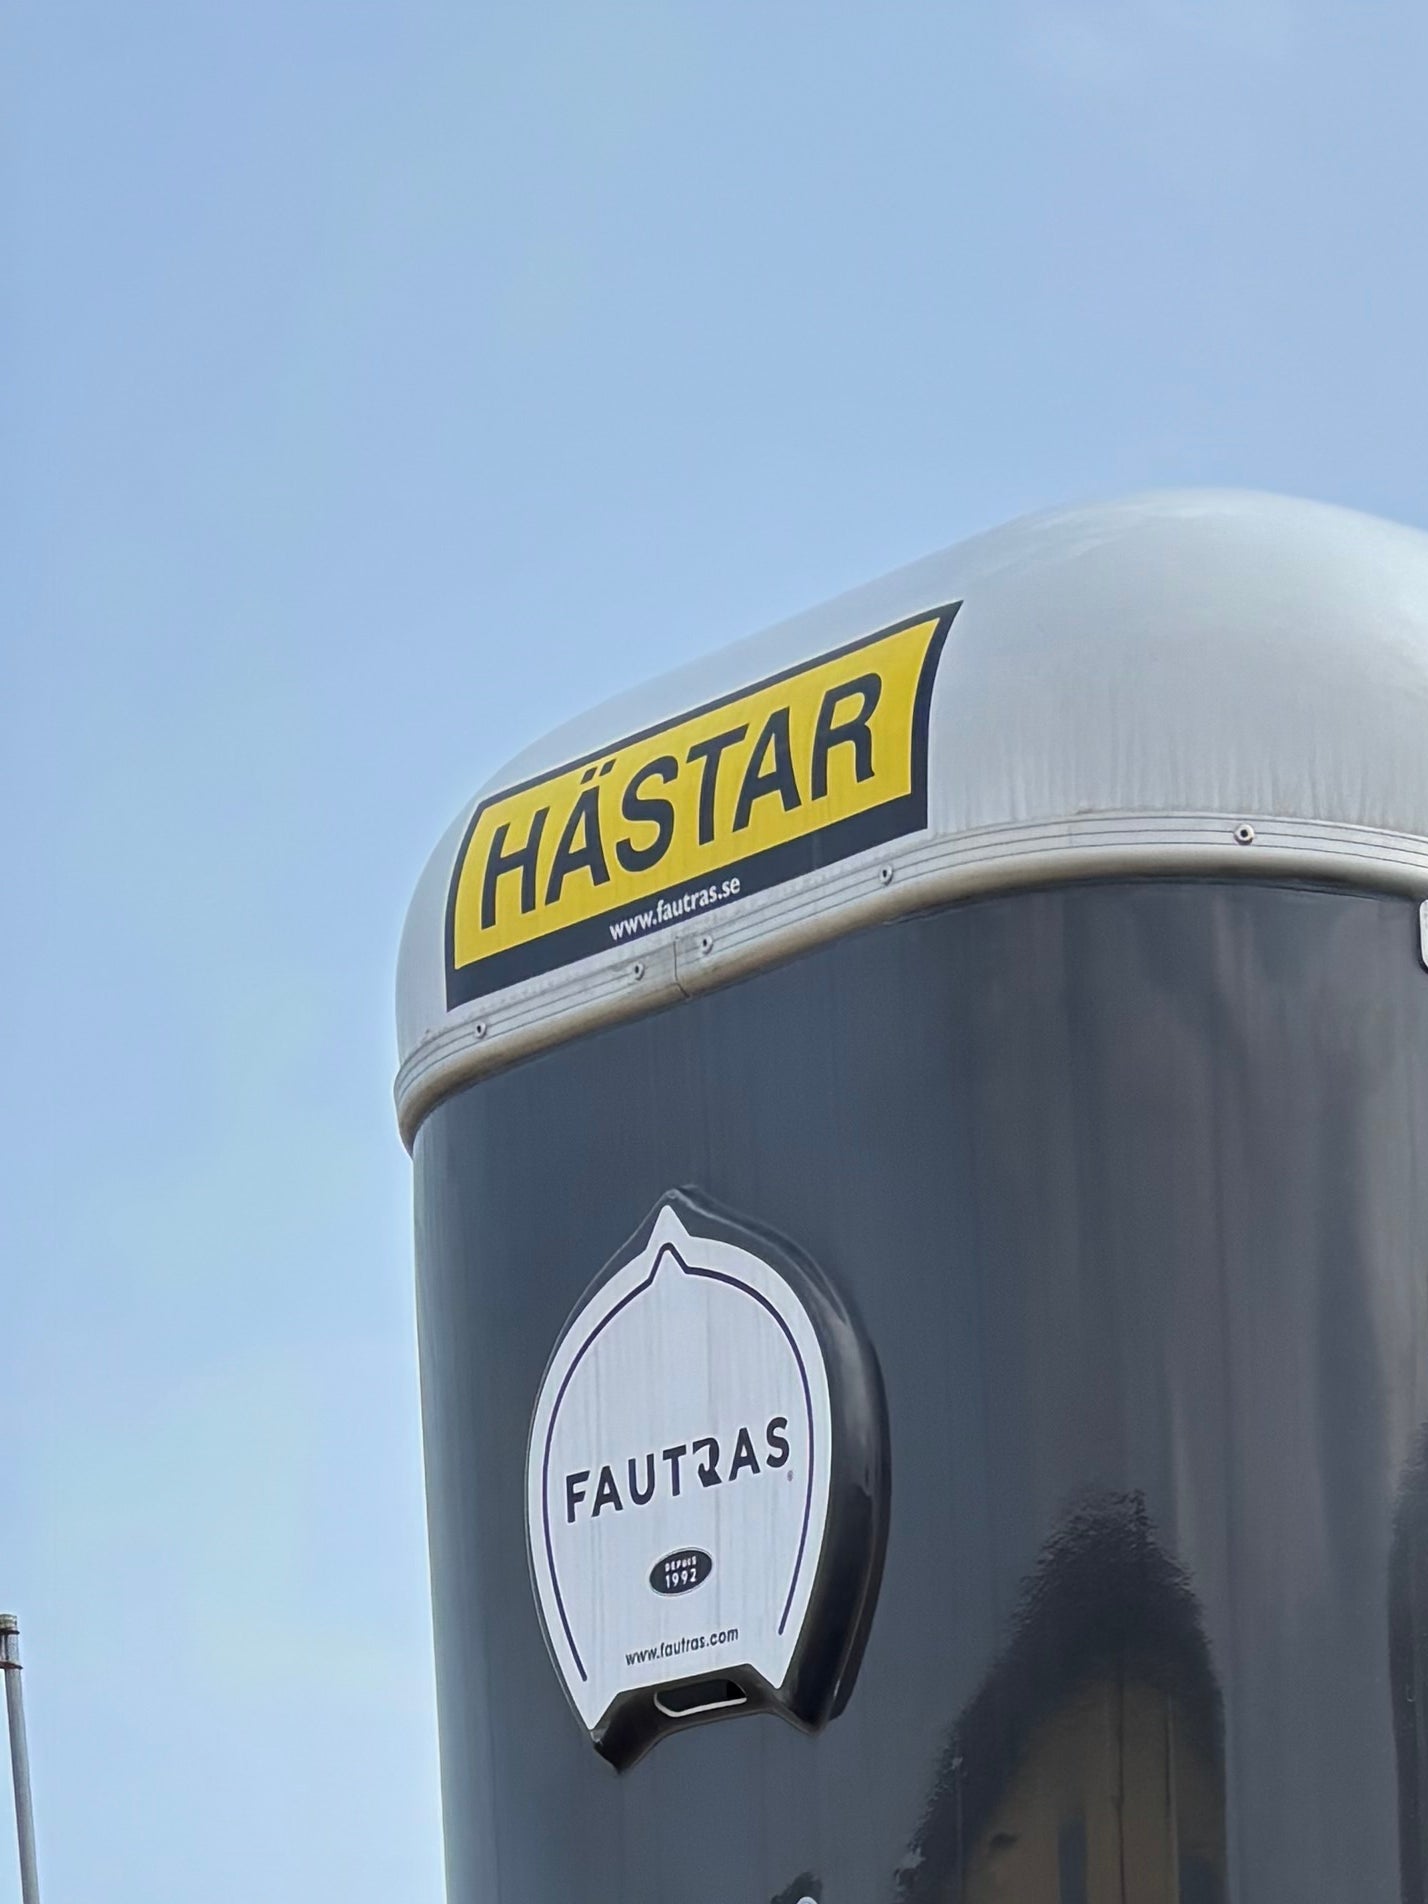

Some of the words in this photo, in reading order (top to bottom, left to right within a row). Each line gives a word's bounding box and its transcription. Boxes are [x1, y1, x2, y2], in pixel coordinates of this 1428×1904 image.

[480, 672, 883, 931] HÄSTAR
[608, 877, 741, 941] www.fautras.se
[565, 1416, 791, 1524] FAUTRAS
[665, 1568, 697, 1589] 1992
[624, 1627, 739, 1667] www.fautras.com
